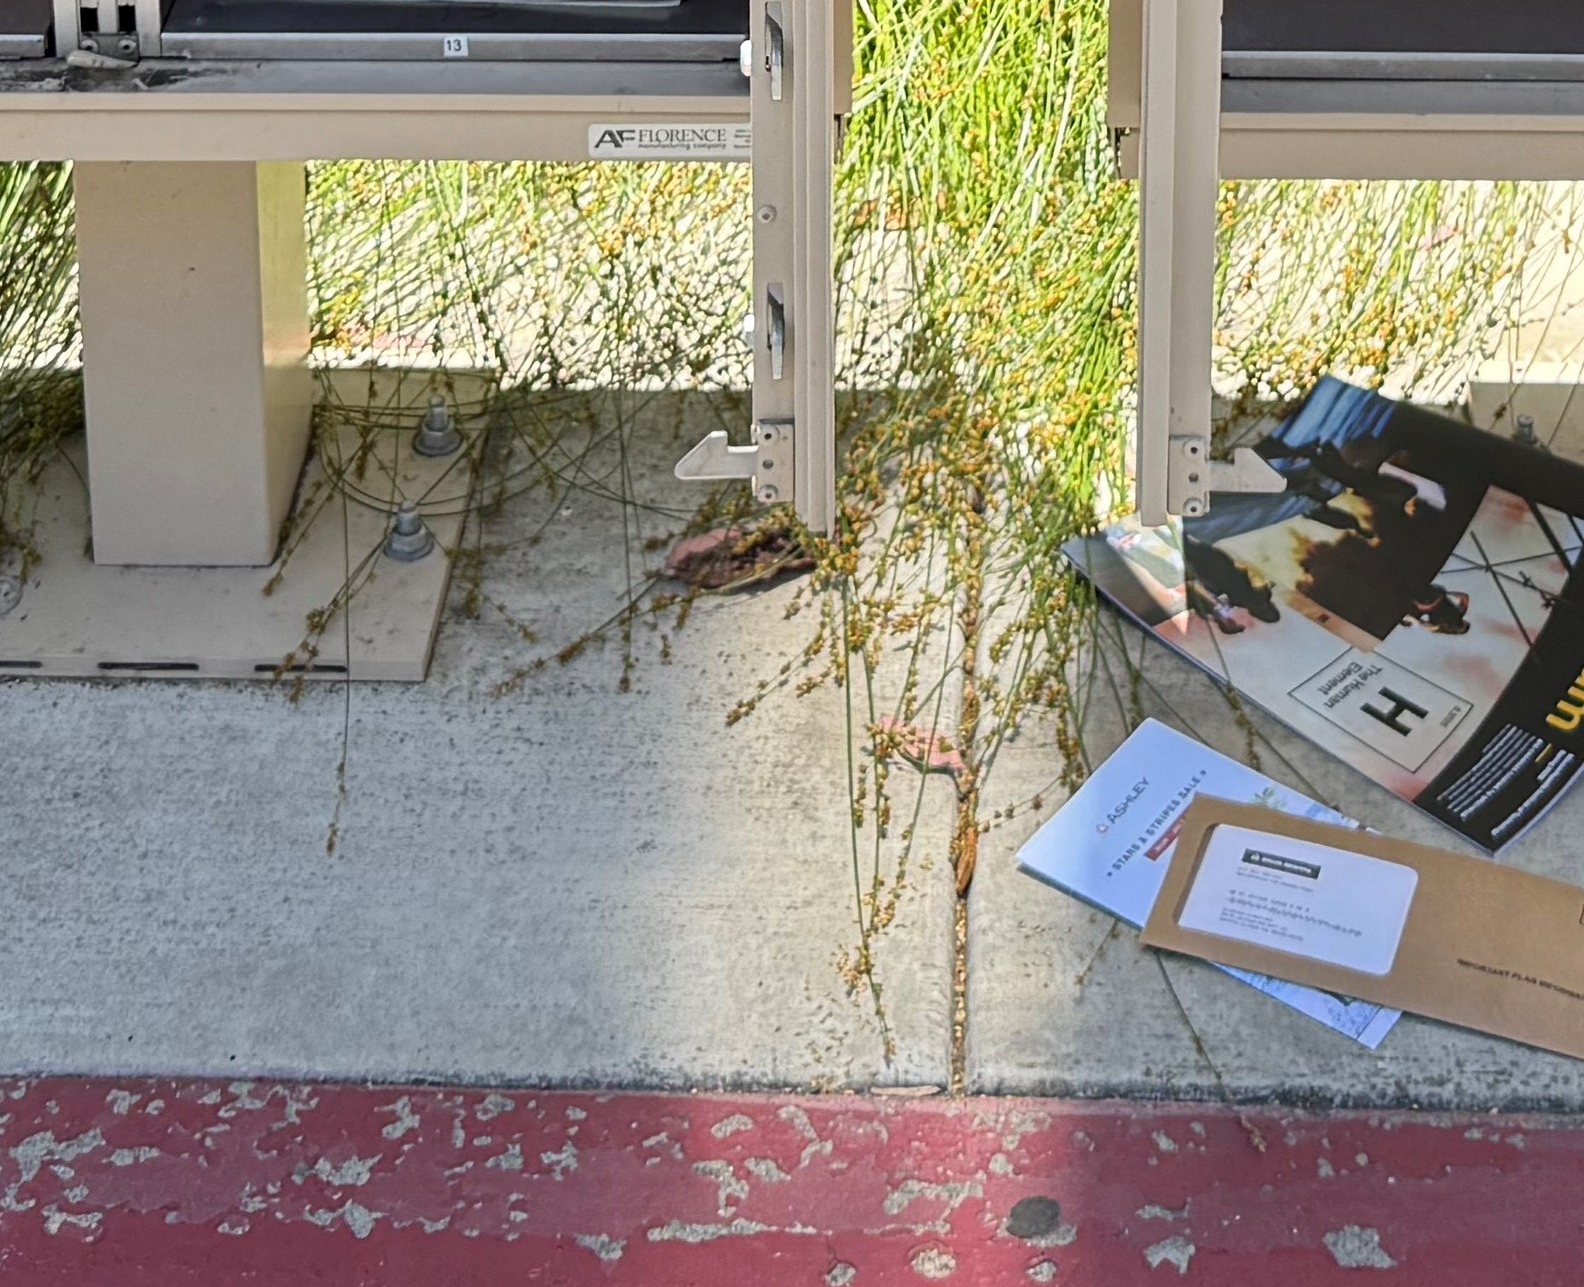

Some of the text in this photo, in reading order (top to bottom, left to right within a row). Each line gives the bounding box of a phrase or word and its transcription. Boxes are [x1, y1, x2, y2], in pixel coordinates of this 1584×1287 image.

[446, 38, 462, 52] 13
[638, 128, 727, 143] FLORENCE
[693, 142, 727, 151] company
[1317, 661, 1364, 696] Element
[1323, 664, 1383, 709] The Human
[1360, 686, 1429, 737] H
[1106, 776, 1150, 824] ASHLEY
[1112, 843, 1141, 870] STARS
[1145, 799, 1181, 836] STRIPES
[1178, 776, 1201, 799] SALE
